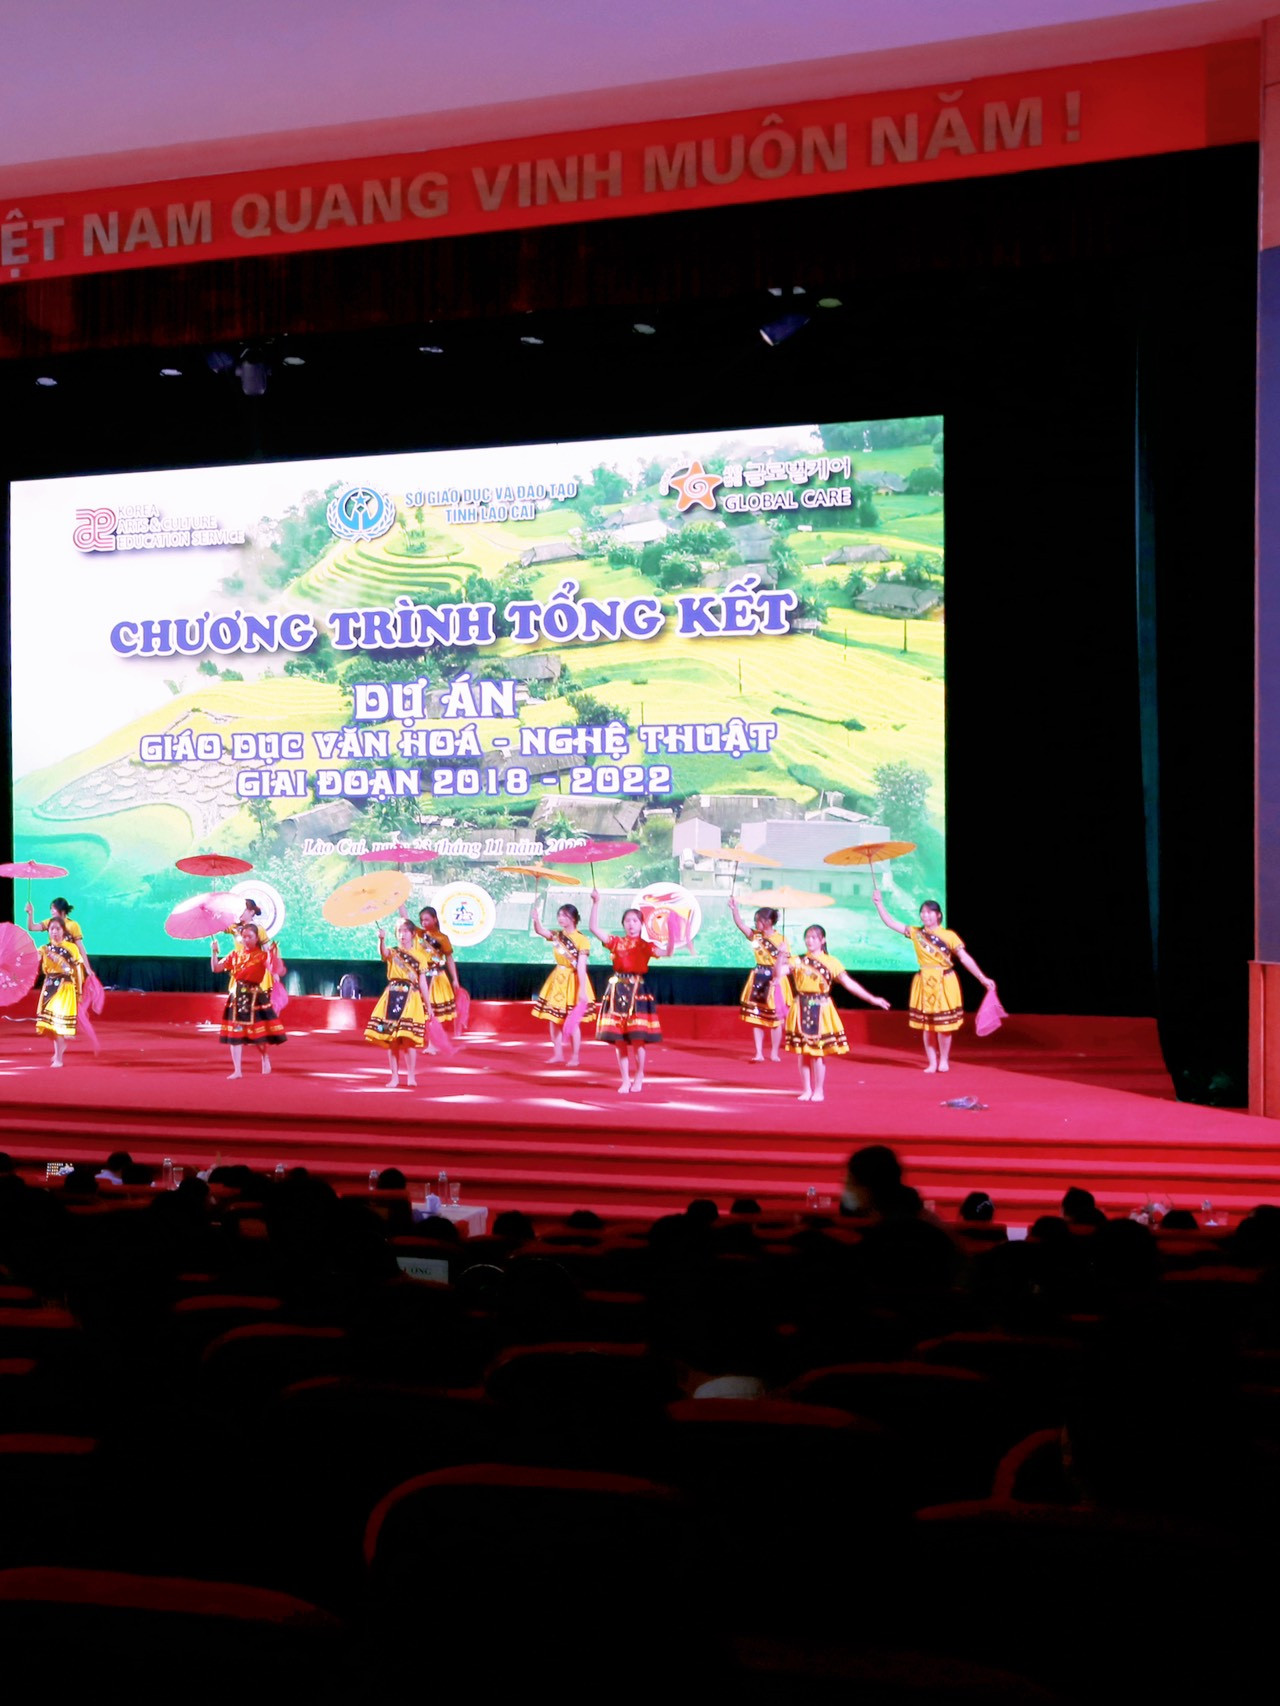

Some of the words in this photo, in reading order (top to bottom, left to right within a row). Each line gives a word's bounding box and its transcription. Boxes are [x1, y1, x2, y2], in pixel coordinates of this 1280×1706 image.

[81, 200, 213, 257] NAM
[230, 172, 449, 239] QUANG
[471, 150, 622, 212] VINH
[643, 112, 848, 193] MUÔN
[870, 89, 1044, 167] NĂM
[744, 456, 851, 487] 글로벌케어
[428, 487, 459, 506] GIÁO
[463, 487, 491, 507] DỤC
[549, 482, 577, 502] TẠO
[724, 490, 798, 512] GLOBAL
[802, 487, 851, 508] CARE
[118, 504, 160, 518] KOREA
[511, 503, 536, 520] CAI
[117, 518, 150, 534] ARTS
[150, 517, 162, 532] &
[162, 516, 218, 531] CULTURE
[117, 532, 190, 550] EDUCATION
[191, 529, 246, 546] SERVICE
[109, 609, 316, 658] CHƯƠNG
[326, 594, 497, 651] TRÌNH
[505, 577, 666, 645] TỔNG
[674, 573, 799, 638] KẾT
[352, 676, 429, 728] DỰ
[441, 672, 518, 720] ÁN
[139, 727, 223, 762] GIÁO
[231, 731, 305, 768] DỤC
[312, 725, 392, 761] VĂN
[397, 722, 484, 760] HOÁ
[519, 718, 630, 762] NGHỆ
[638, 716, 778, 760] THUẬT
[236, 767, 308, 799] GIAI
[315, 766, 421, 802] ĐOẠN
[431, 765, 531, 797] 2018
[569, 764, 674, 796] 2022
[302, 838, 334, 855] Lào
[436, 838, 481, 859] tháng
[483, 838, 504, 855] 11
[506, 838, 544, 855] năm
